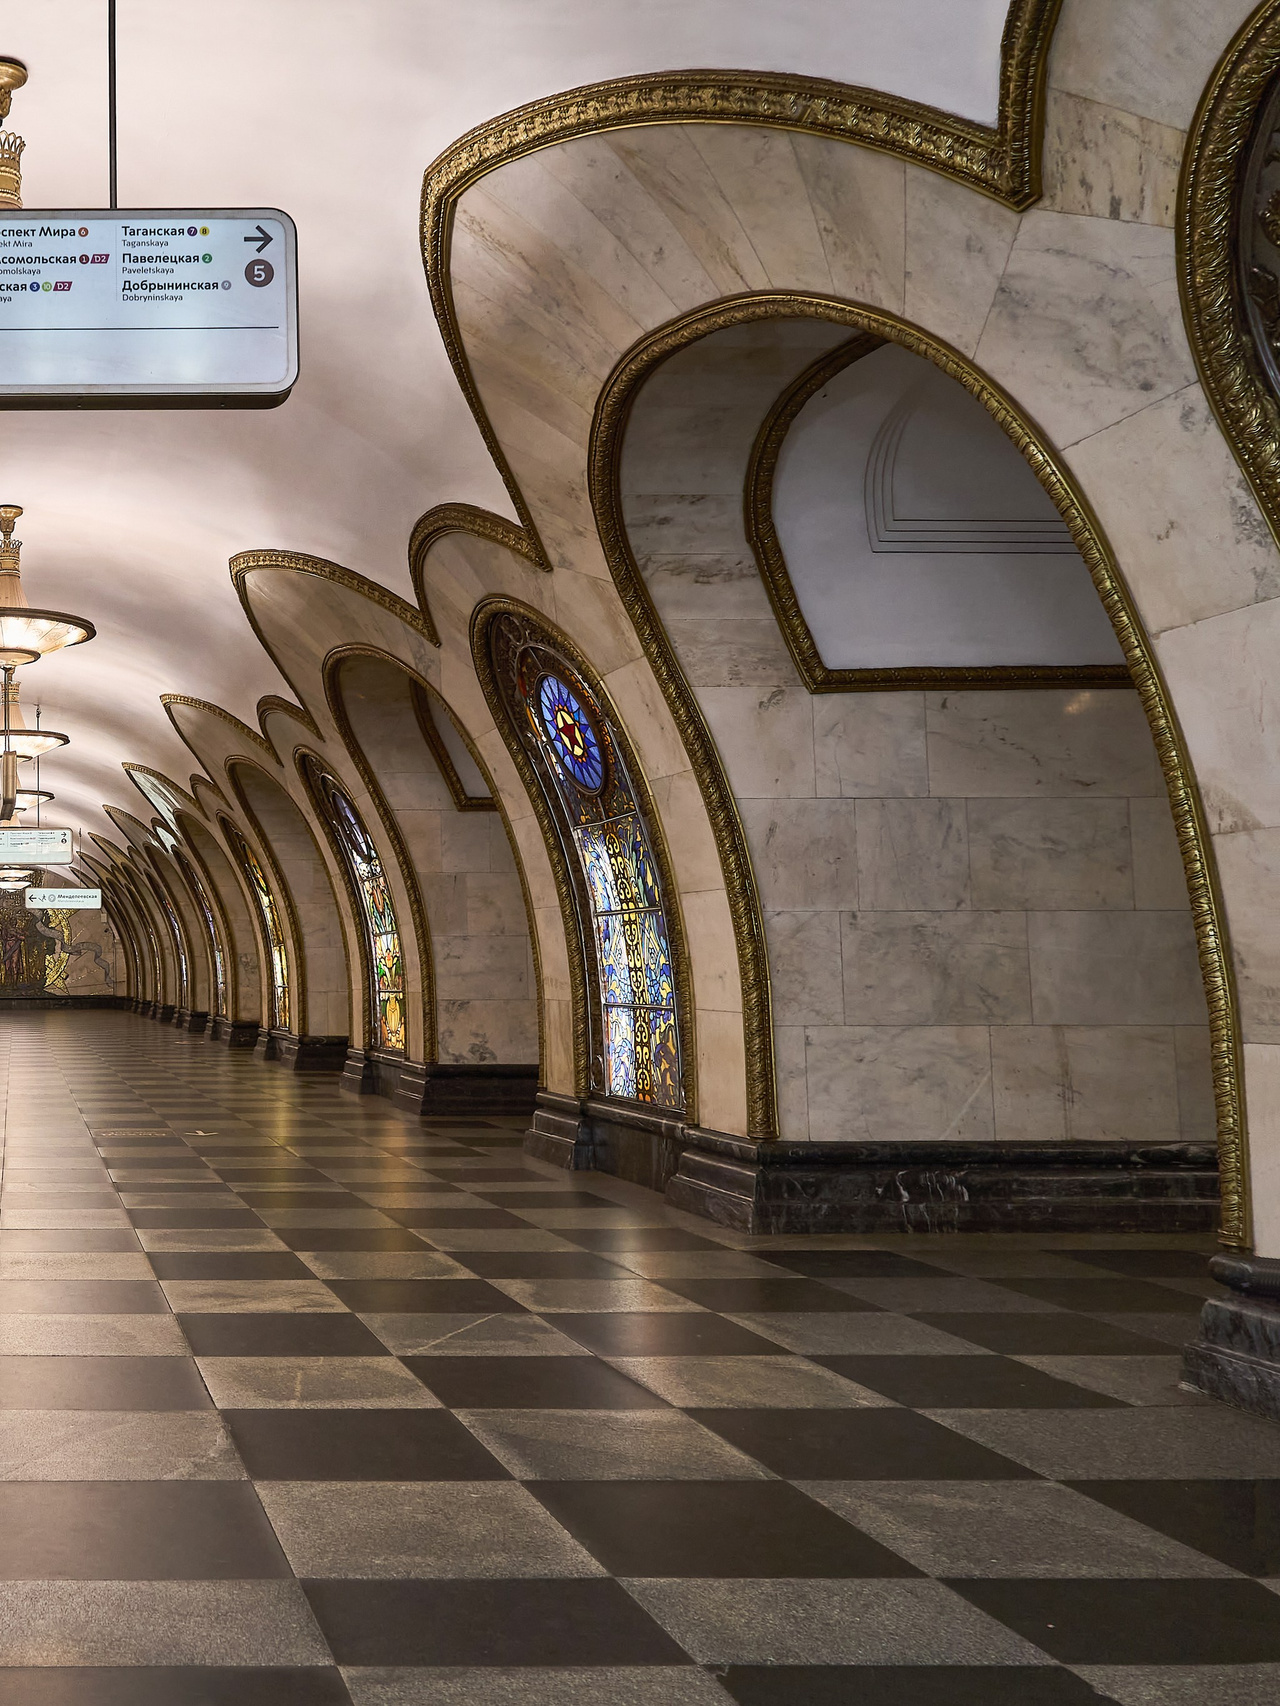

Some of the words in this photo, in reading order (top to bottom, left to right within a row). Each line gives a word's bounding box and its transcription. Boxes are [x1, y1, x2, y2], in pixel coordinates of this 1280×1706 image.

[39, 226, 75, 239] Мира
[122, 226, 184, 236] Таганская
[122, 239, 168, 248] Taganskaya
[122, 254, 199, 265] Павелецкая
[122, 266, 174, 275] Paveletskaya
[253, 265, 265, 281] 5
[122, 280, 218, 293] Добрынинская
[122, 293, 183, 302] Dobryninskaya
